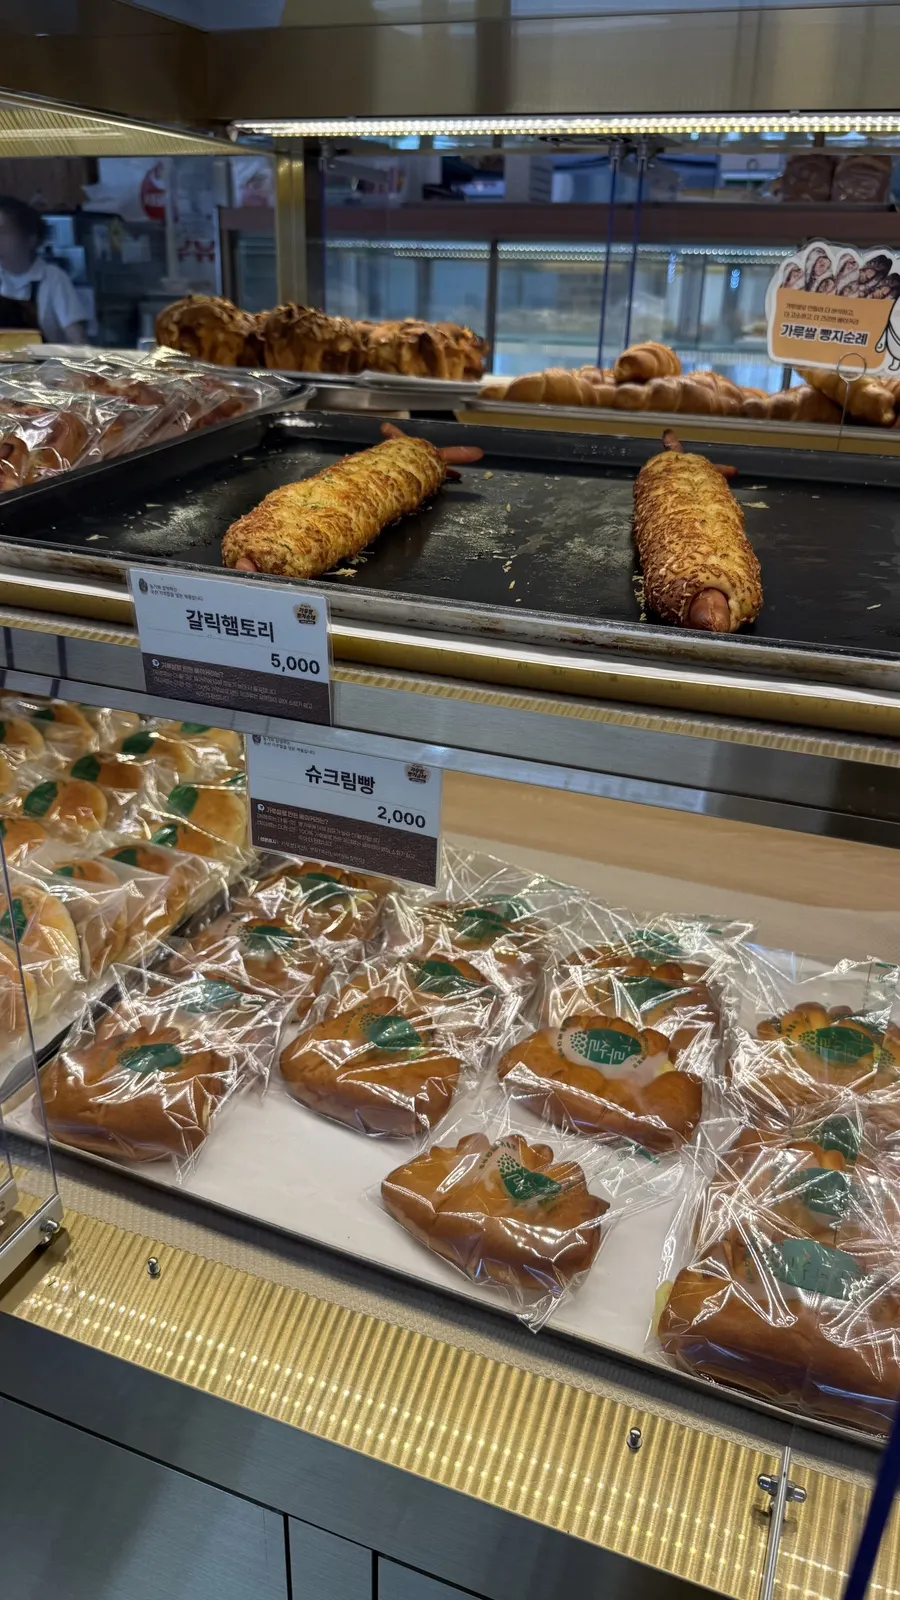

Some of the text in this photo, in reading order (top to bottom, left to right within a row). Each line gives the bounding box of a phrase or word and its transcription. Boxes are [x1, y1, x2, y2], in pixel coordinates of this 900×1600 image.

[780, 324, 869, 346] 가루쌀 빵지순례
[185, 609, 275, 643] 갈릭햄토리
[270, 652, 321, 675] 5,000
[304, 764, 376, 795] 슈크림빵
[377, 805, 427, 830] 2,000
